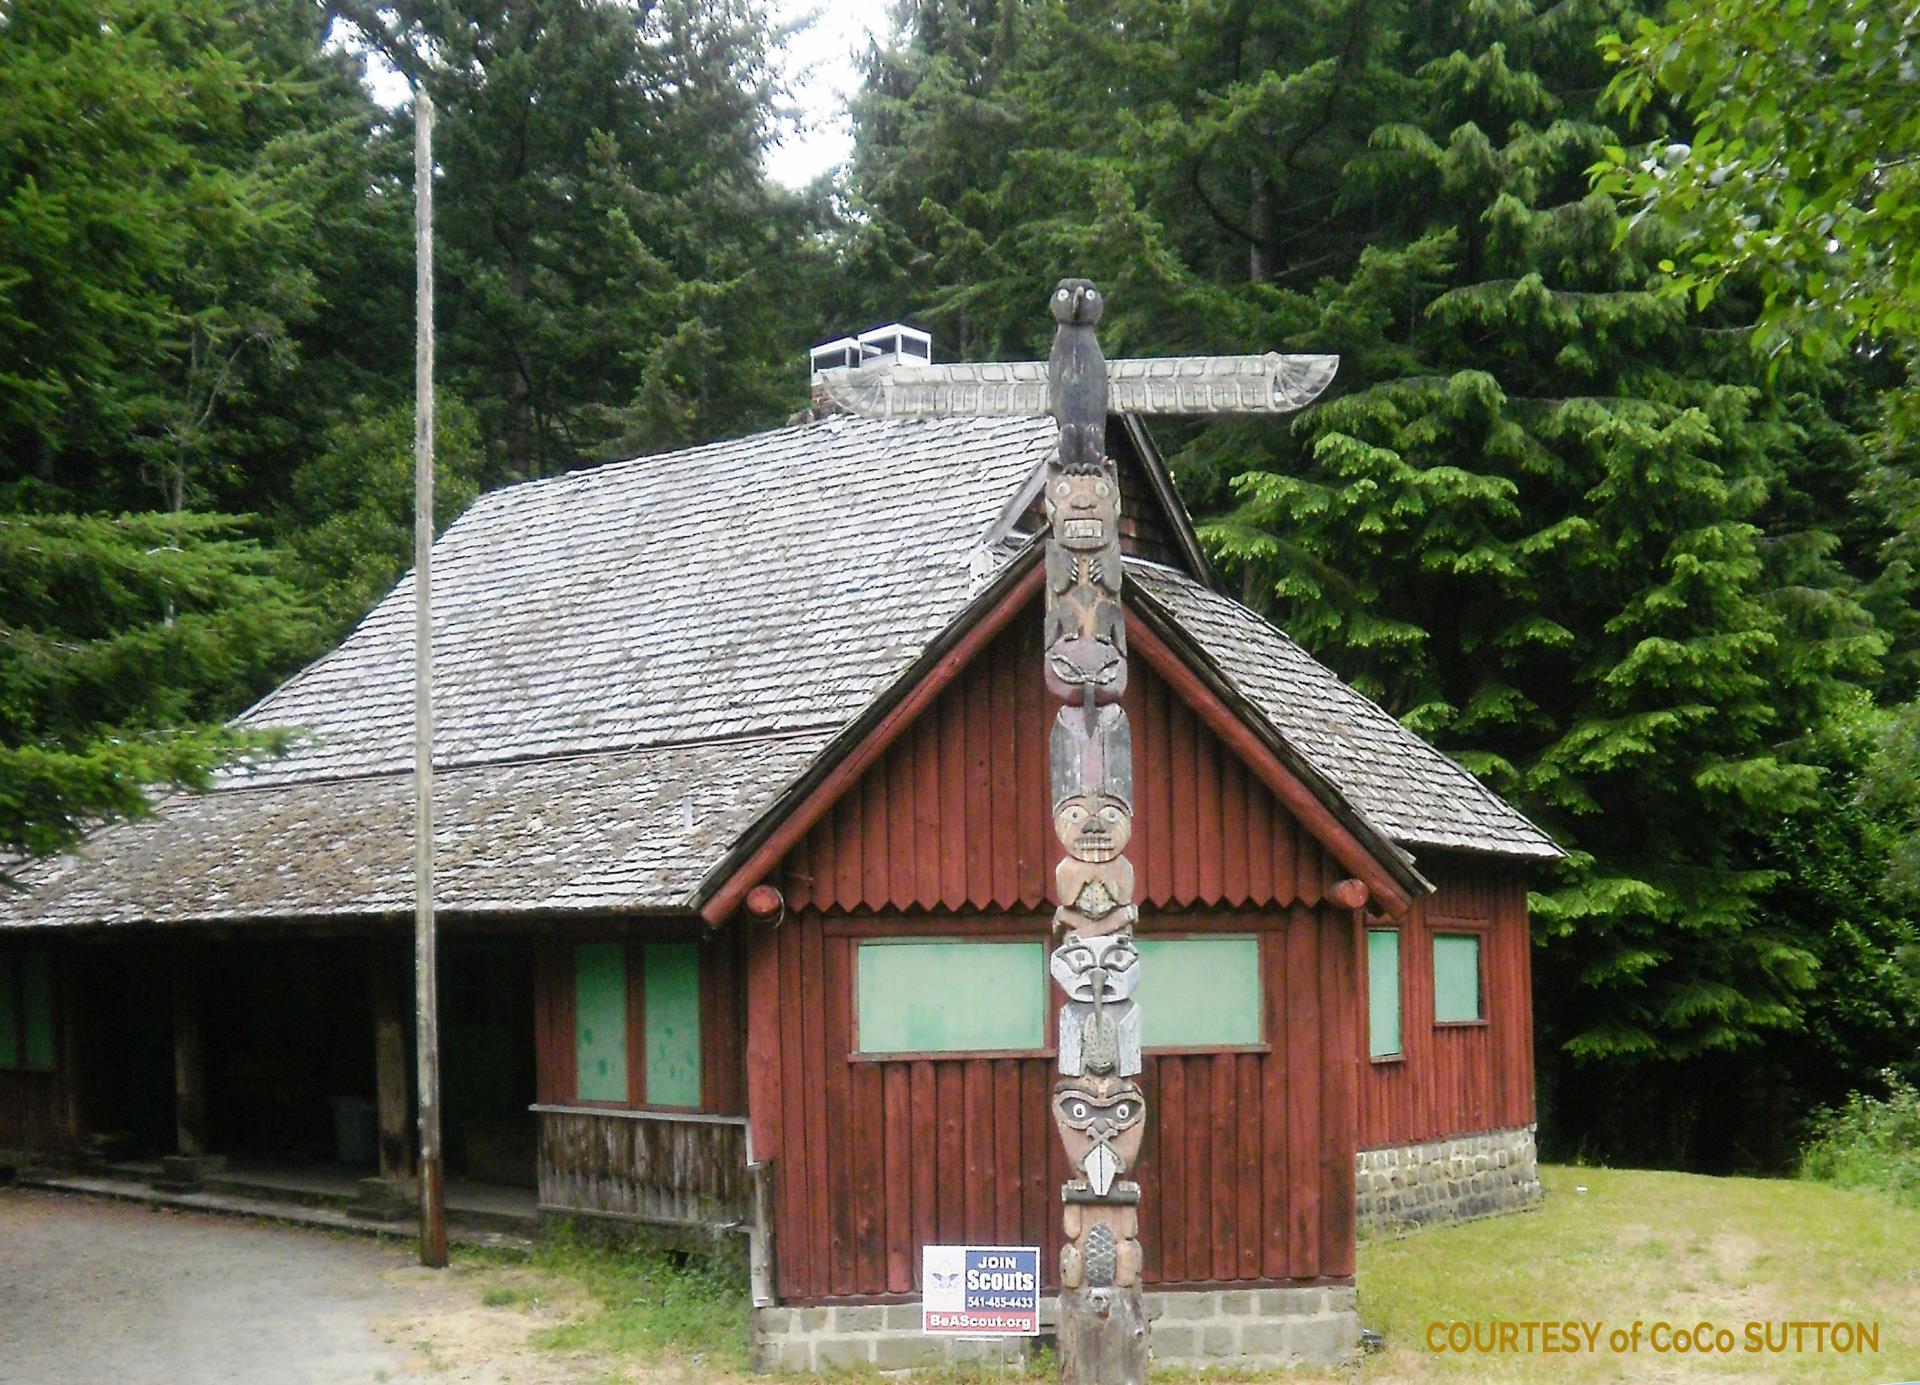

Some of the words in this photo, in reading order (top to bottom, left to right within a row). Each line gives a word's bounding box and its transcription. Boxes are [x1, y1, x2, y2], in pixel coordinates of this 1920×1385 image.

[978, 1256, 1017, 1269] JOIN
[967, 1269, 1034, 1291] Scouts
[967, 1296, 1034, 1308] 541-485-4433
[930, 1314, 1031, 1331] BeAScout.org
